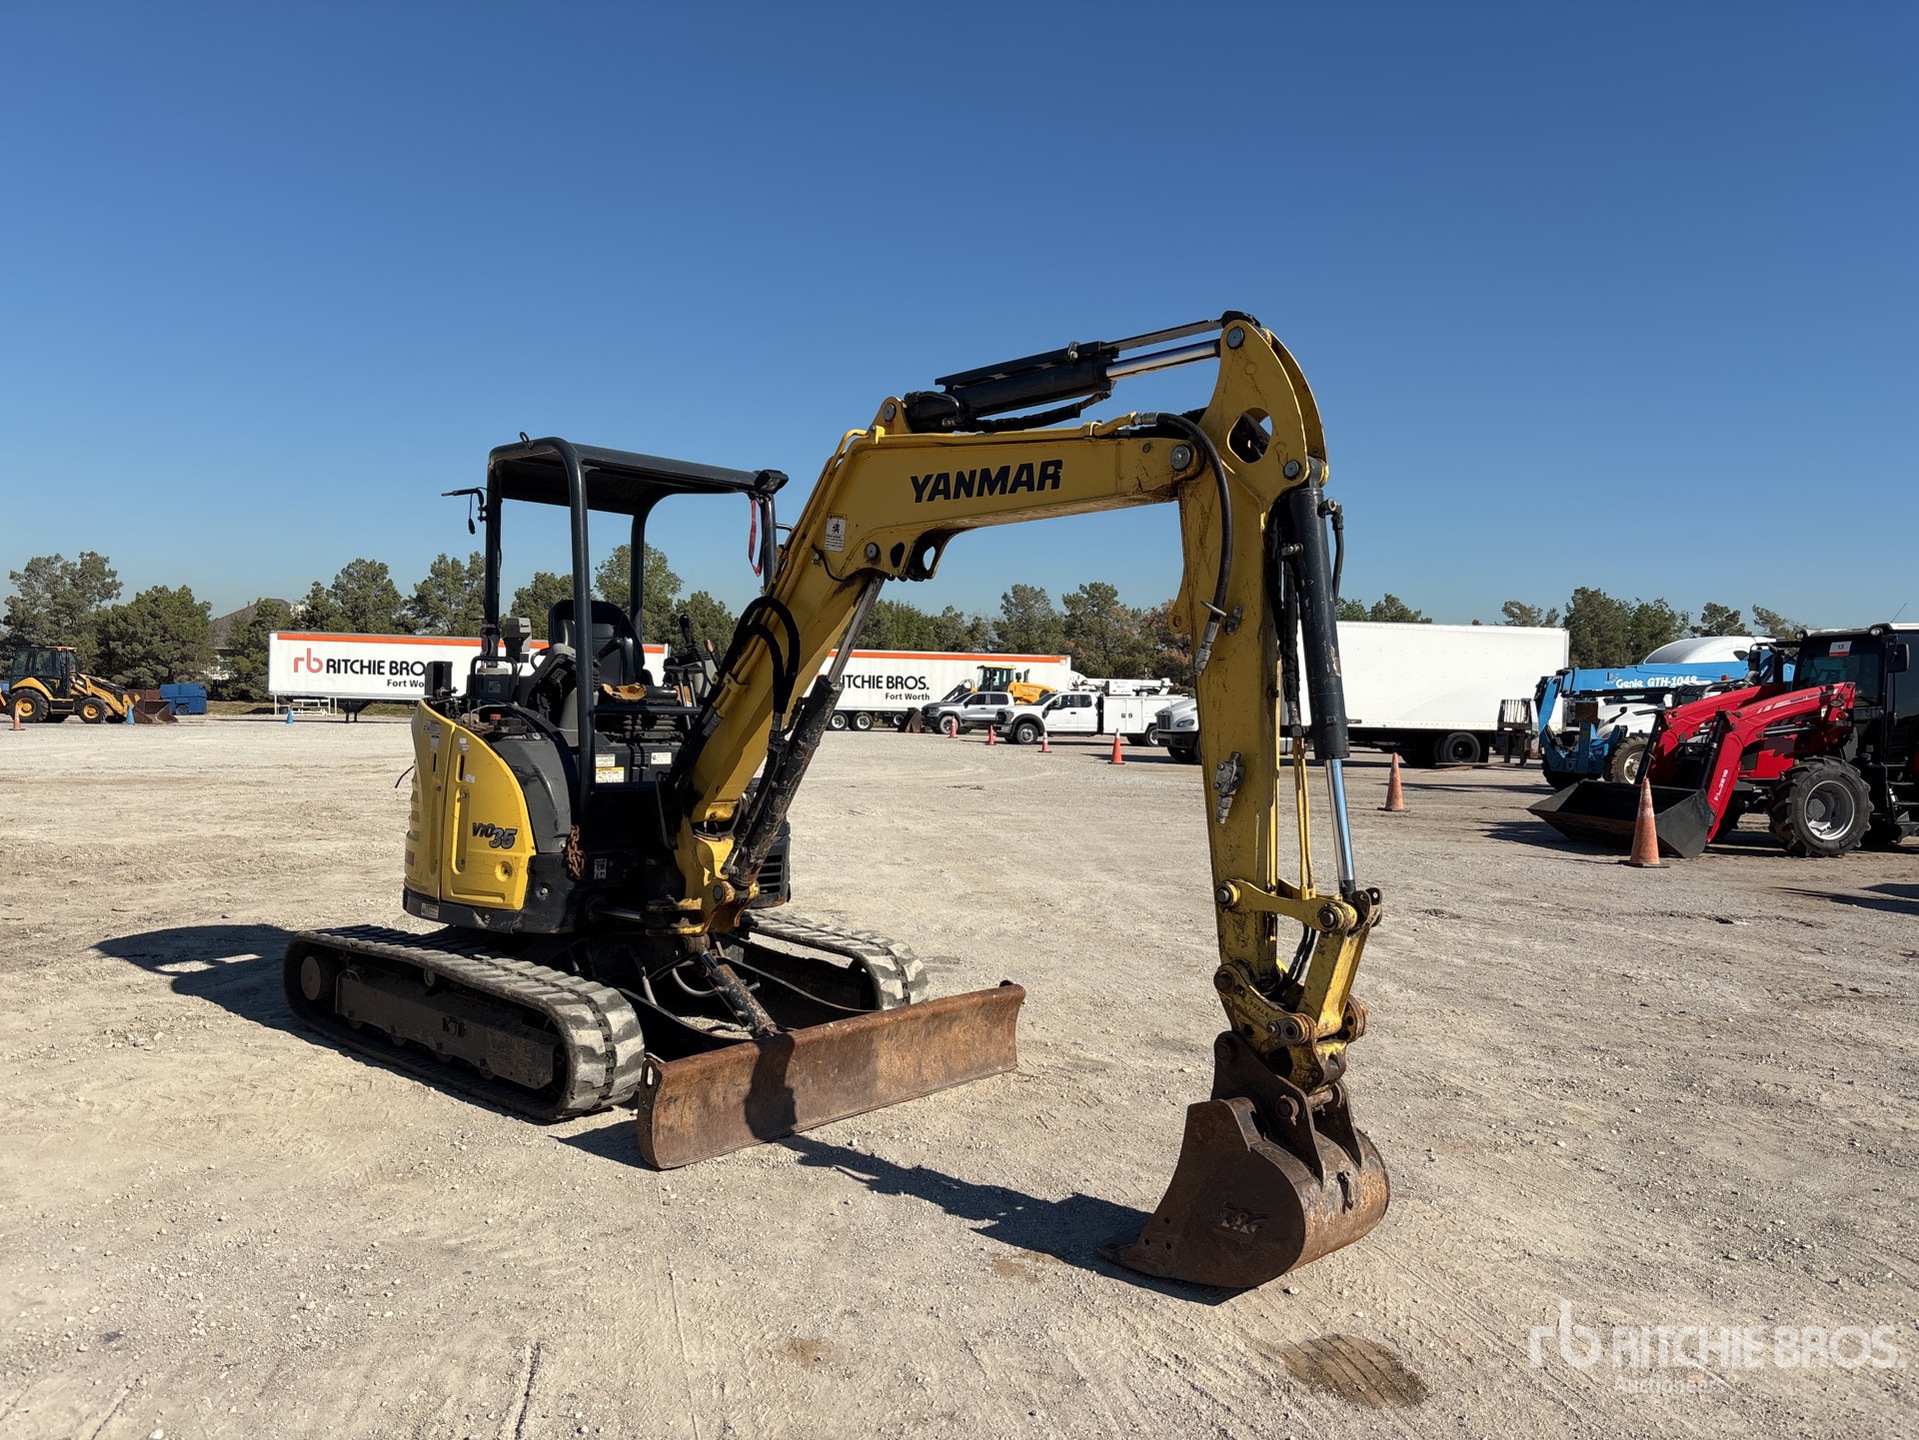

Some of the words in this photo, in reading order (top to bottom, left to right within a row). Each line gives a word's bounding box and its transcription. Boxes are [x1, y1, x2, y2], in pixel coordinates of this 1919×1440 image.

[910, 459, 1064, 503] YANMAR
[293, 648, 323, 673] rb
[326, 658, 385, 675] RITCHIE
[389, 660, 427, 676] BRO
[387, 679, 407, 688] Fort
[841, 674, 883, 689] ITCHIE
[886, 675, 930, 690] BROS.
[1615, 678, 1644, 688] Genie
[885, 692, 903, 700] Fort
[904, 692, 930, 701] Worth
